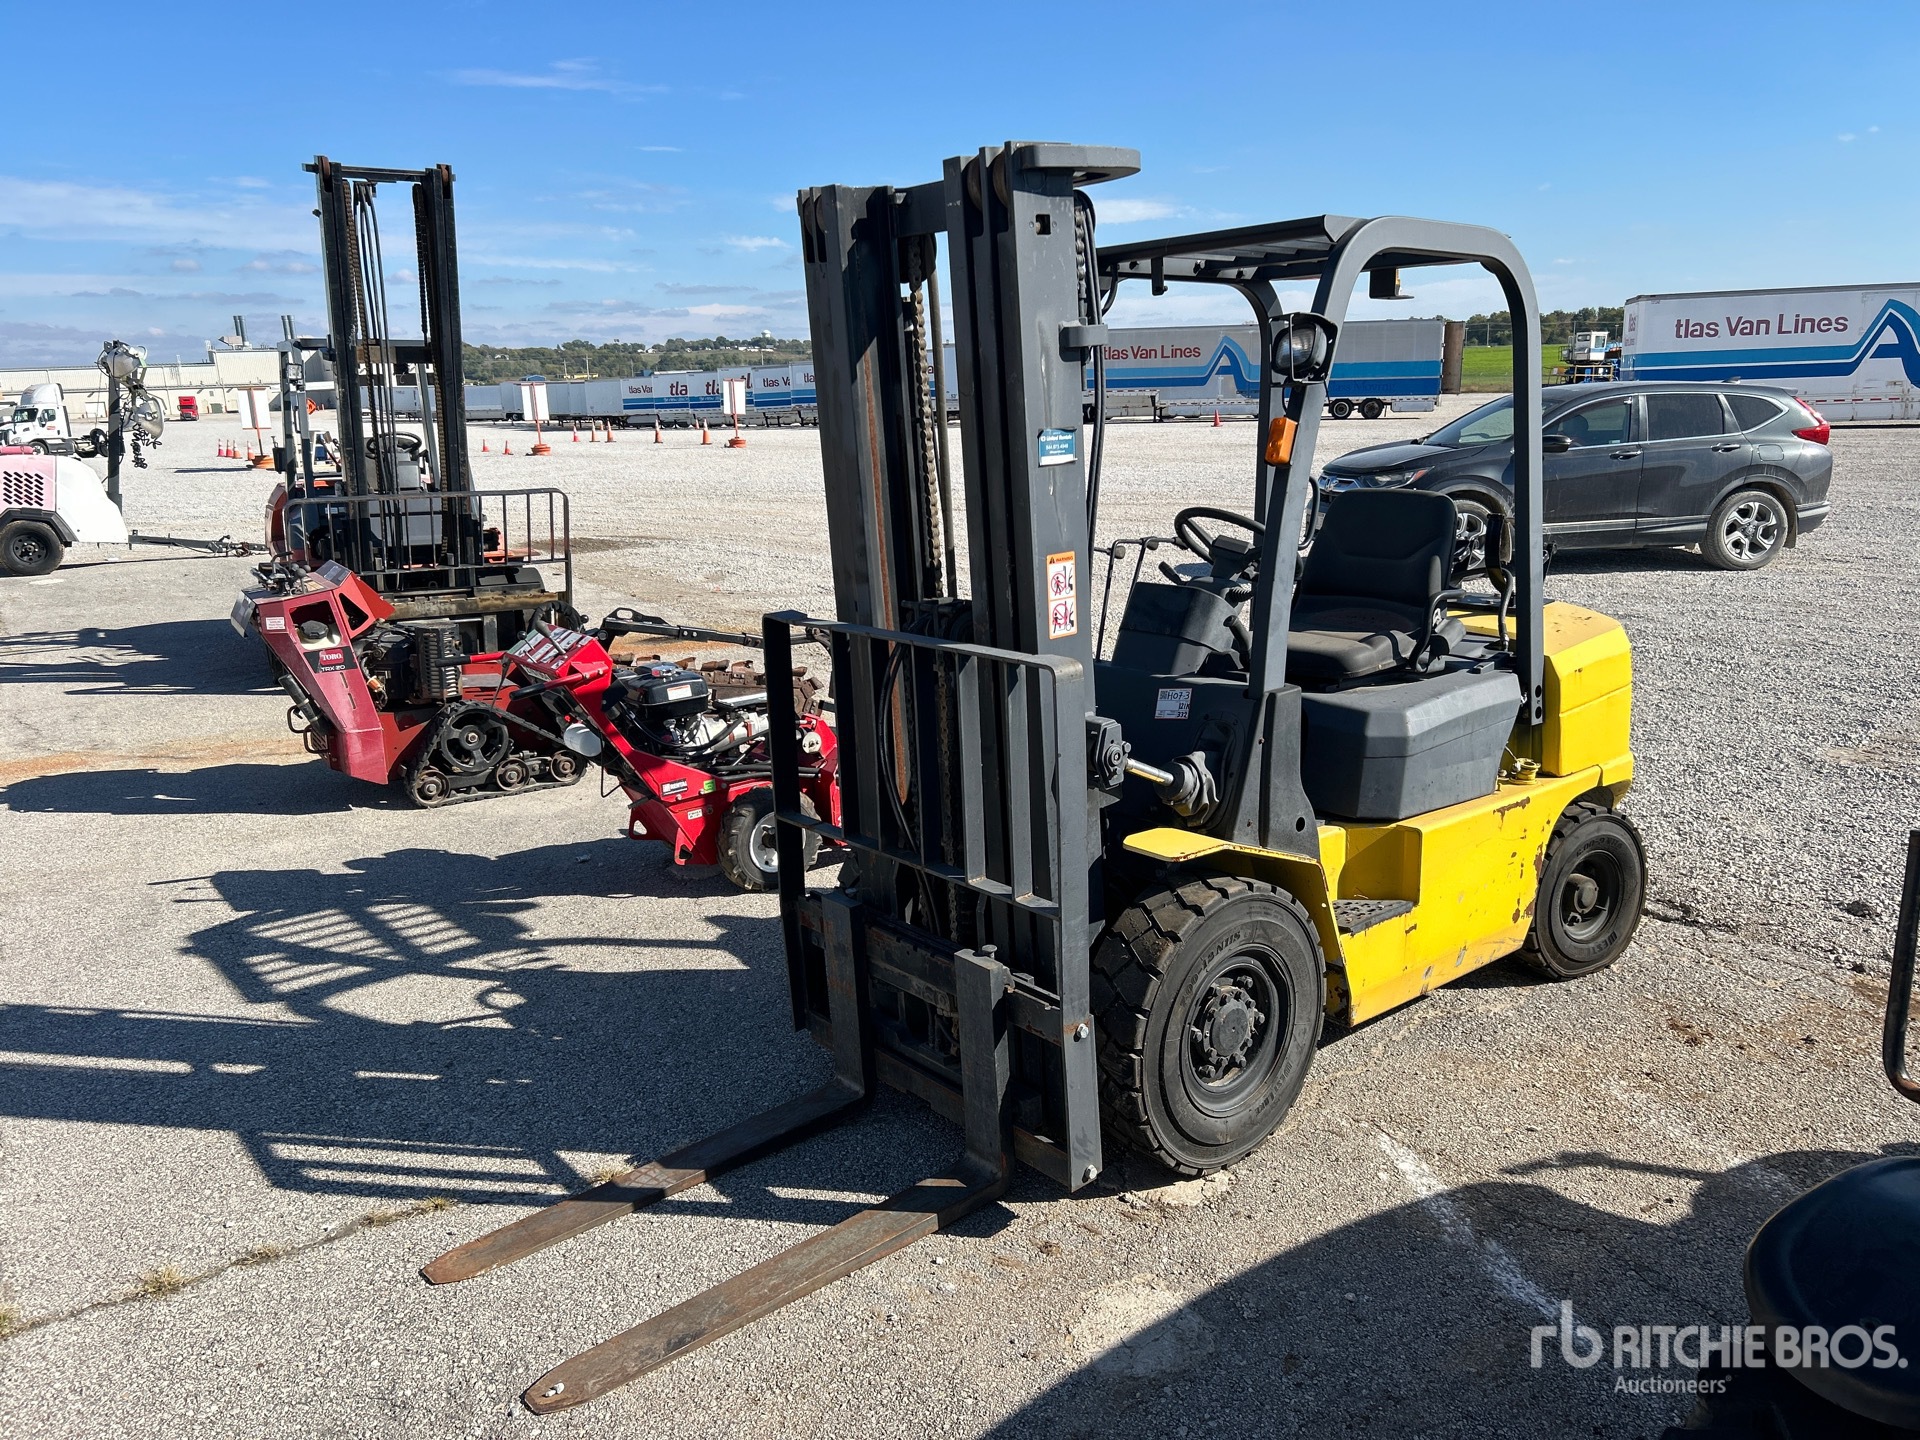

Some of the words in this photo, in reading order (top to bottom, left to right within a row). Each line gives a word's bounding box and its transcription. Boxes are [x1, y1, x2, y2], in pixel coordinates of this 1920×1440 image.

[1675, 318, 1719, 339] tlas
[1725, 316, 1771, 336] Van
[1777, 313, 1848, 335] Lines
[1130, 345, 1158, 359] Van
[1160, 344, 1201, 359] Lines
[762, 378, 780, 388] tlas
[803, 373, 815, 383] tla
[669, 381, 688, 396] tla
[321, 653, 343, 661] TORO
